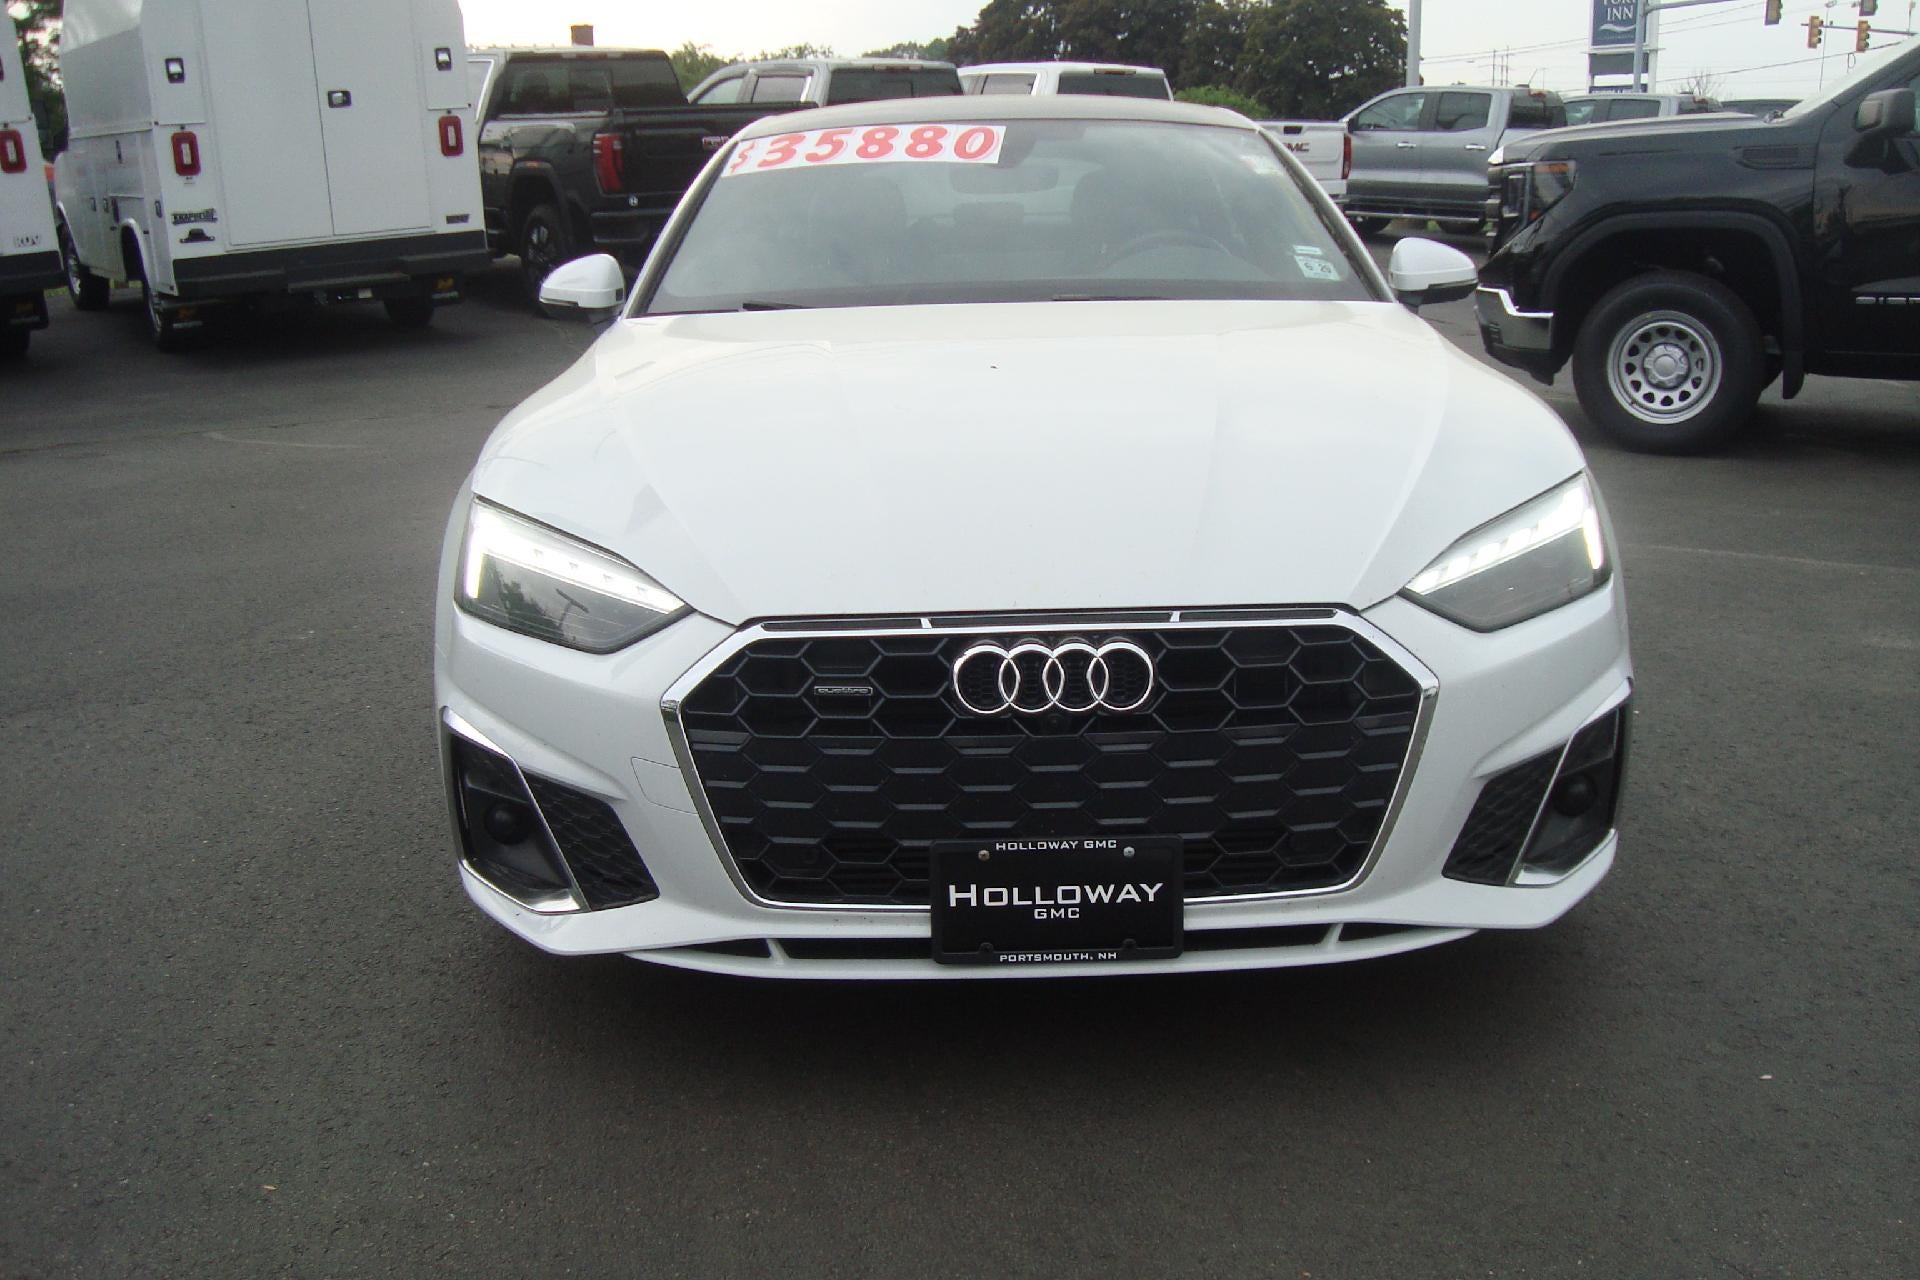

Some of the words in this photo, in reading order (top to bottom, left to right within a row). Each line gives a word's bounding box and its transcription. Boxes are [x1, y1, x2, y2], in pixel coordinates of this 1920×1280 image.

[1607, 6, 1634, 20] INN
[730, 125, 997, 174] $35880
[995, 840, 1079, 851] HOLLOWAY
[1083, 839, 1117, 849] GMC
[949, 883, 1164, 907] HOLLOWAY
[1033, 907, 1080, 920] GMC
[1098, 952, 1117, 960] NH
